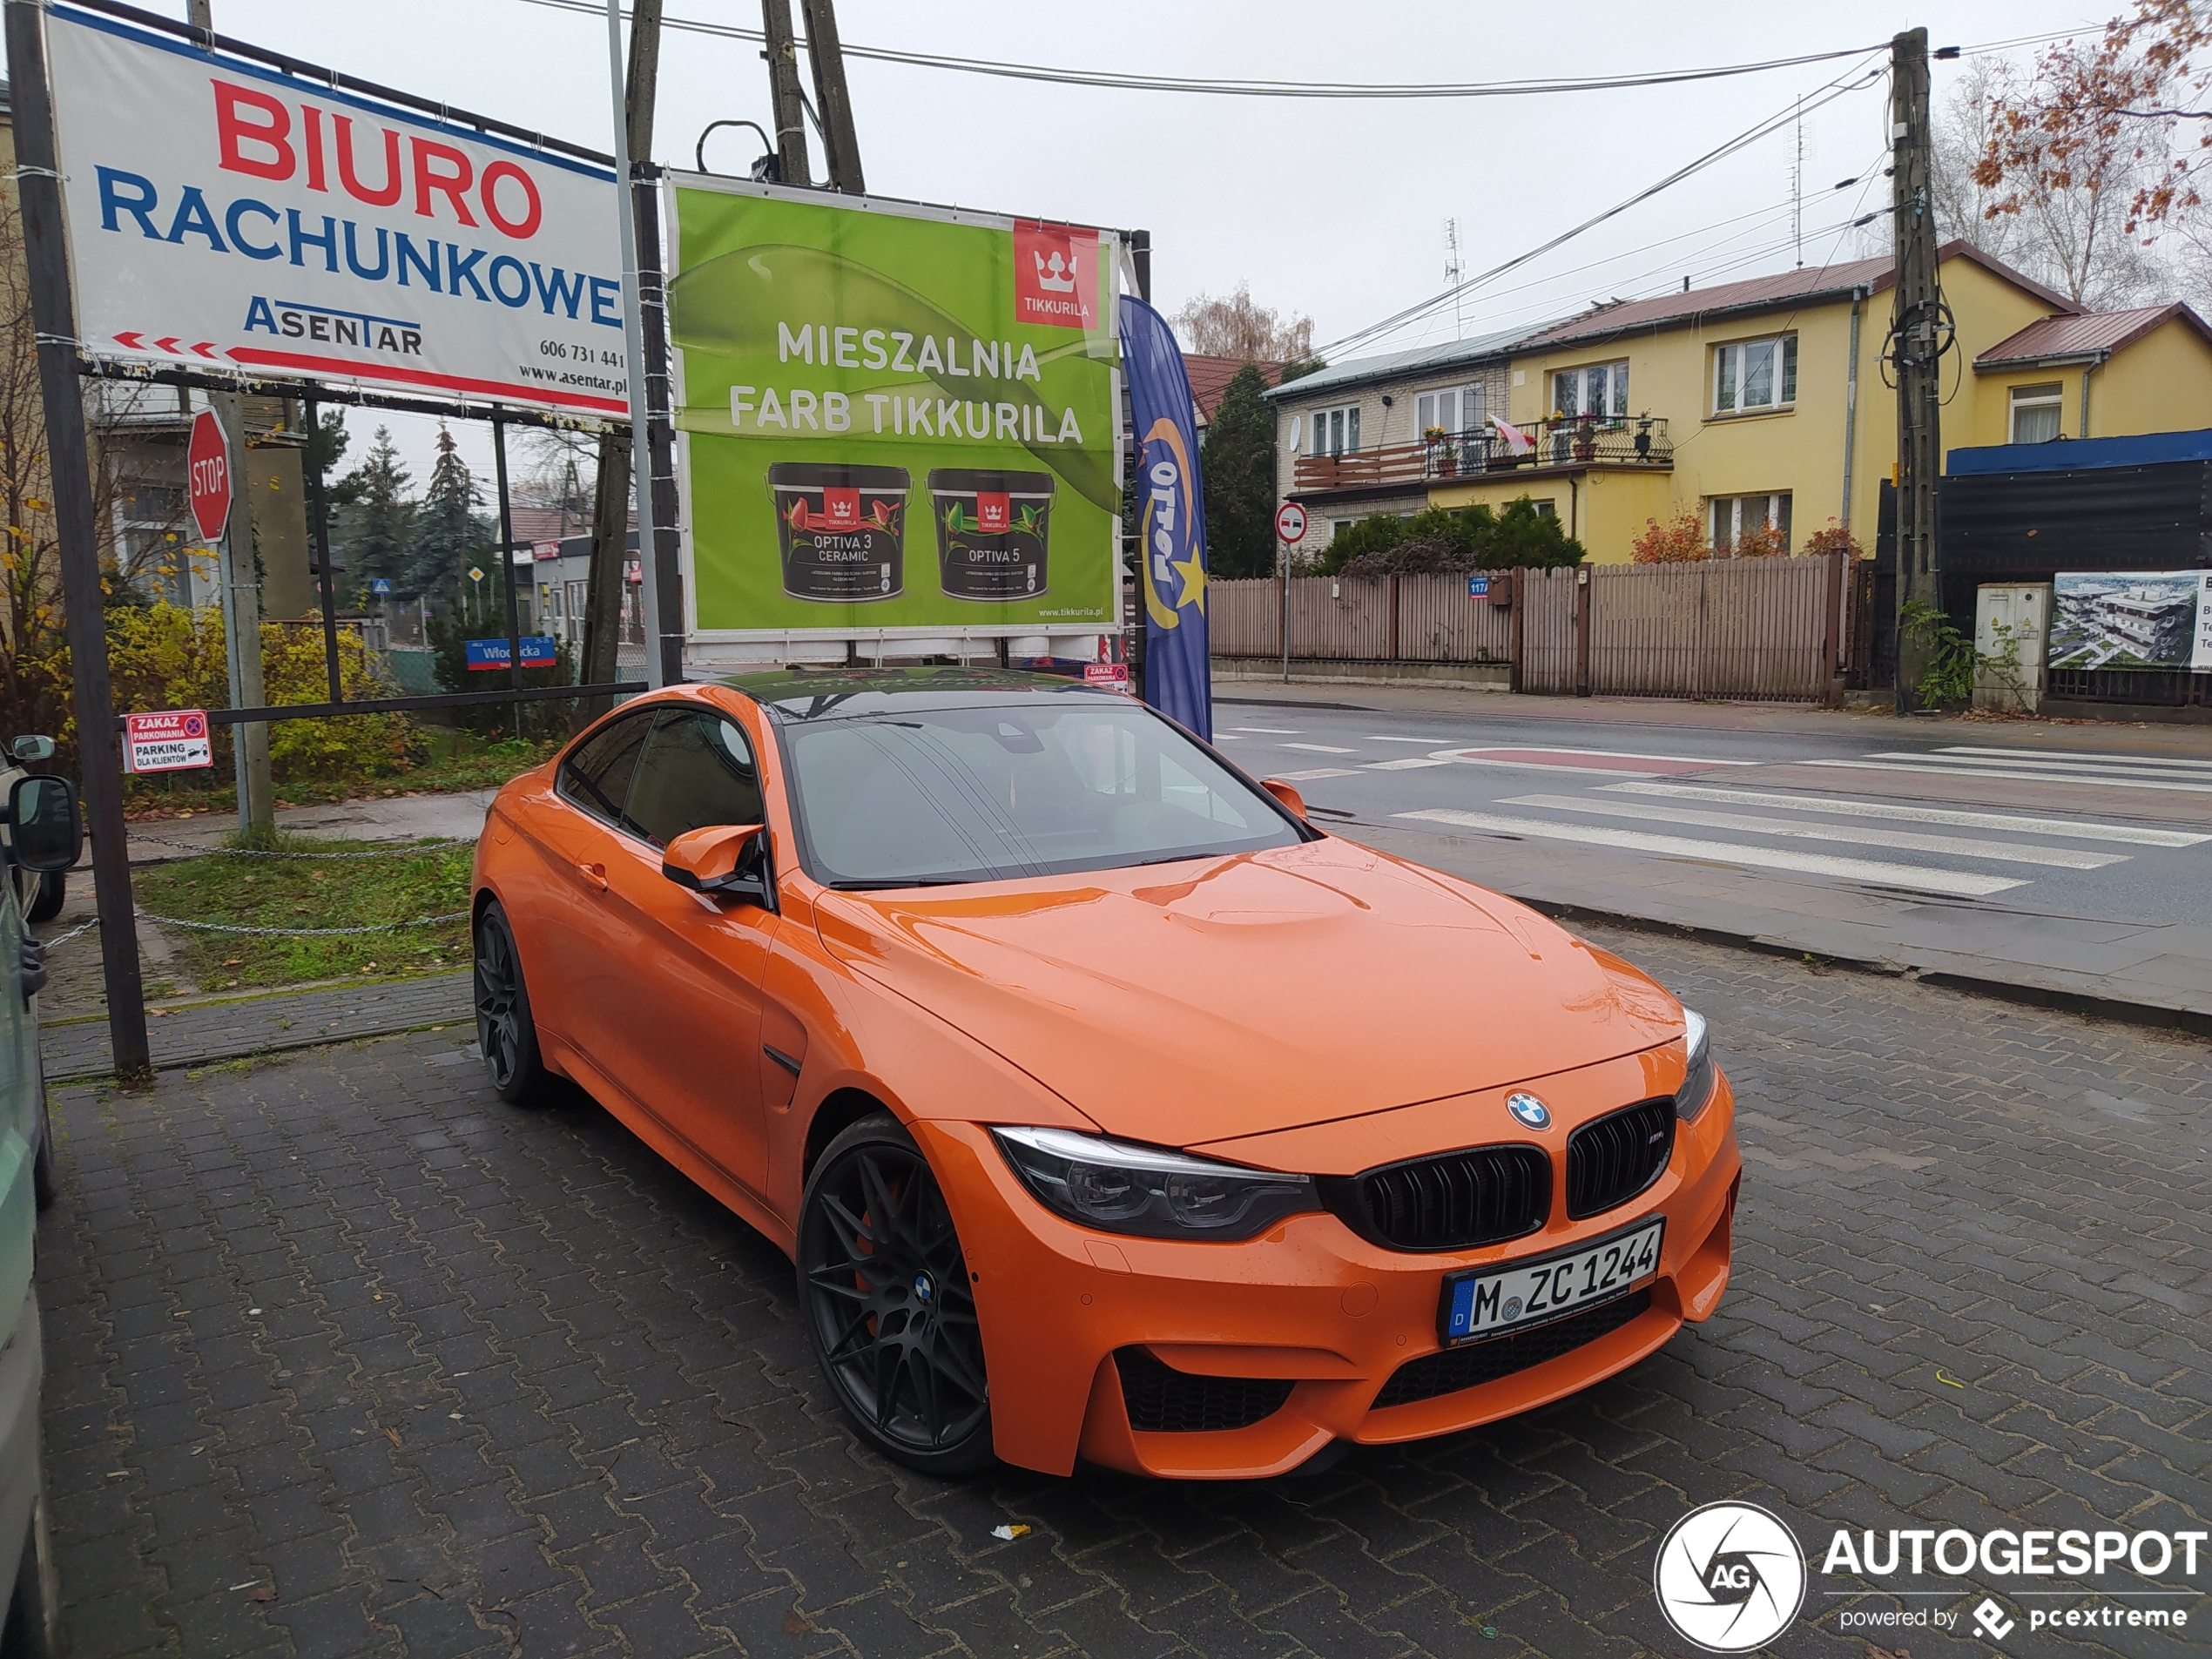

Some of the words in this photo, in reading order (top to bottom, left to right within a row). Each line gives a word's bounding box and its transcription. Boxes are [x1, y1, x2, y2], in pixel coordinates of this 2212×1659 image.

[210, 78, 542, 239] BIURO
[94, 165, 623, 329] RACHUNKOWE
[1024, 296, 1089, 318] TIKKURILA
[540, 340, 566, 359] 606
[571, 345, 595, 363] 731
[601, 350, 624, 368] 441
[777, 320, 1041, 383] MIESZALNIA
[519, 365, 628, 395] www.asentar.pl
[730, 385, 850, 432] FARB
[864, 394, 1083, 445] TIKKURILA
[193, 455, 225, 496] STOP
[814, 535, 861, 550] OPTIVA
[864, 534, 872, 549] 3
[819, 550, 869, 562] CERAMIC
[968, 550, 1009, 563] OPTIVA
[1013, 548, 1020, 562] 5
[1039, 607, 1103, 617] www.tikkurila.pl
[138, 717, 179, 730] ZAKAZ
[133, 730, 185, 740] PARKOWANIA
[136, 744, 185, 756] PARKING
[137, 758, 150, 766] DLA
[152, 753, 186, 765] KLIENTÓW
[1510, 1094, 1538, 1108] BMW
[1473, 1279, 1501, 1326] M
[1525, 1262, 1573, 1313] ZC
[1580, 1230, 1656, 1298] 1244
[1454, 1313, 1464, 1326] D
